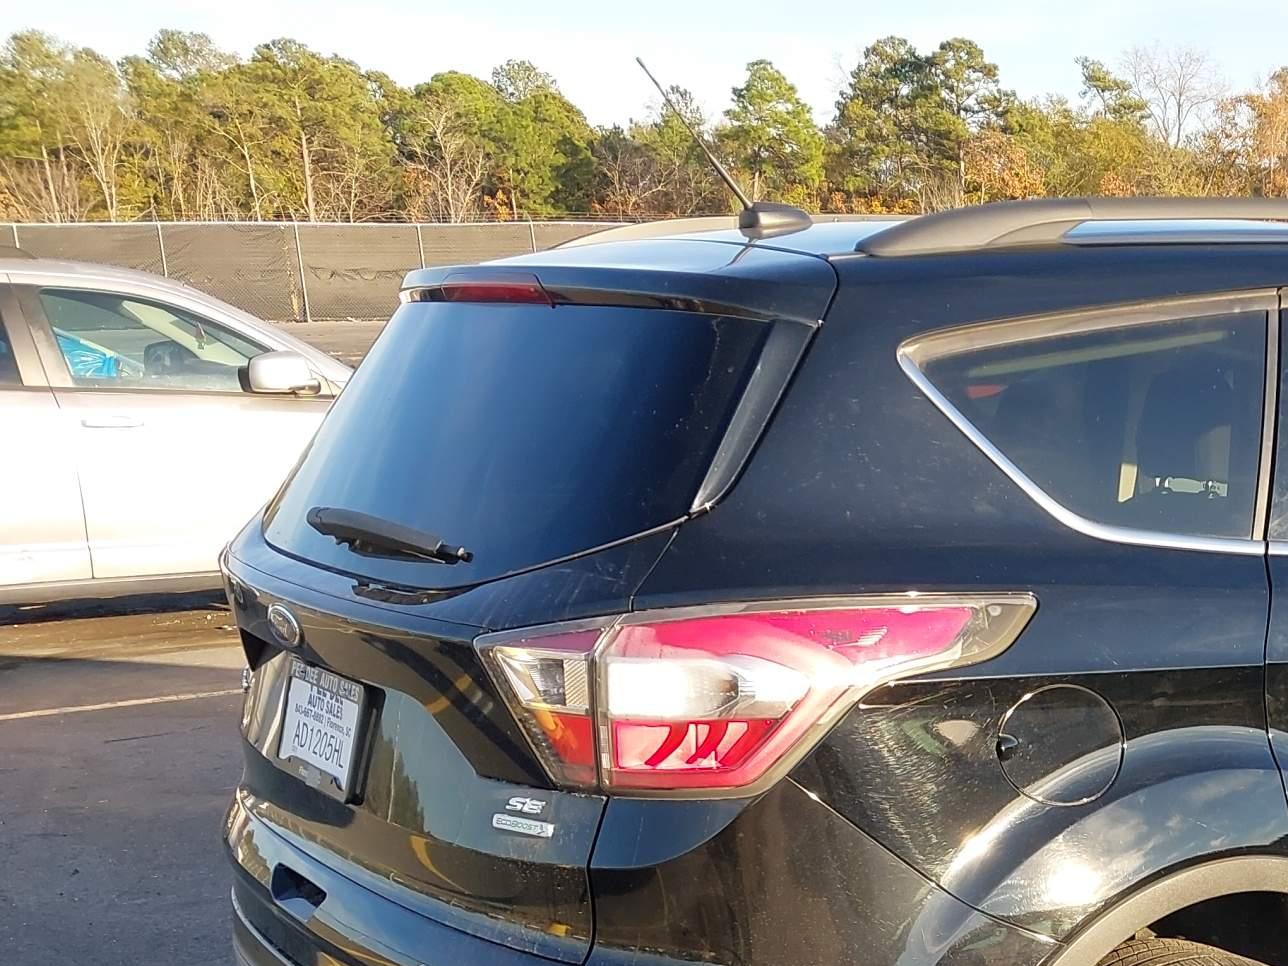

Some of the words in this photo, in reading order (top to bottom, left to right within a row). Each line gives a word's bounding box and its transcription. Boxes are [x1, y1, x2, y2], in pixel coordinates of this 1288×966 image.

[305, 666, 319, 684] DEE
[319, 672, 339, 693] AUTO
[339, 680, 360, 702] SALES
[307, 692, 325, 712] AUTO
[324, 699, 343, 721] SALES
[292, 718, 344, 769] AD1205HL
[505, 797, 547, 815] SE
